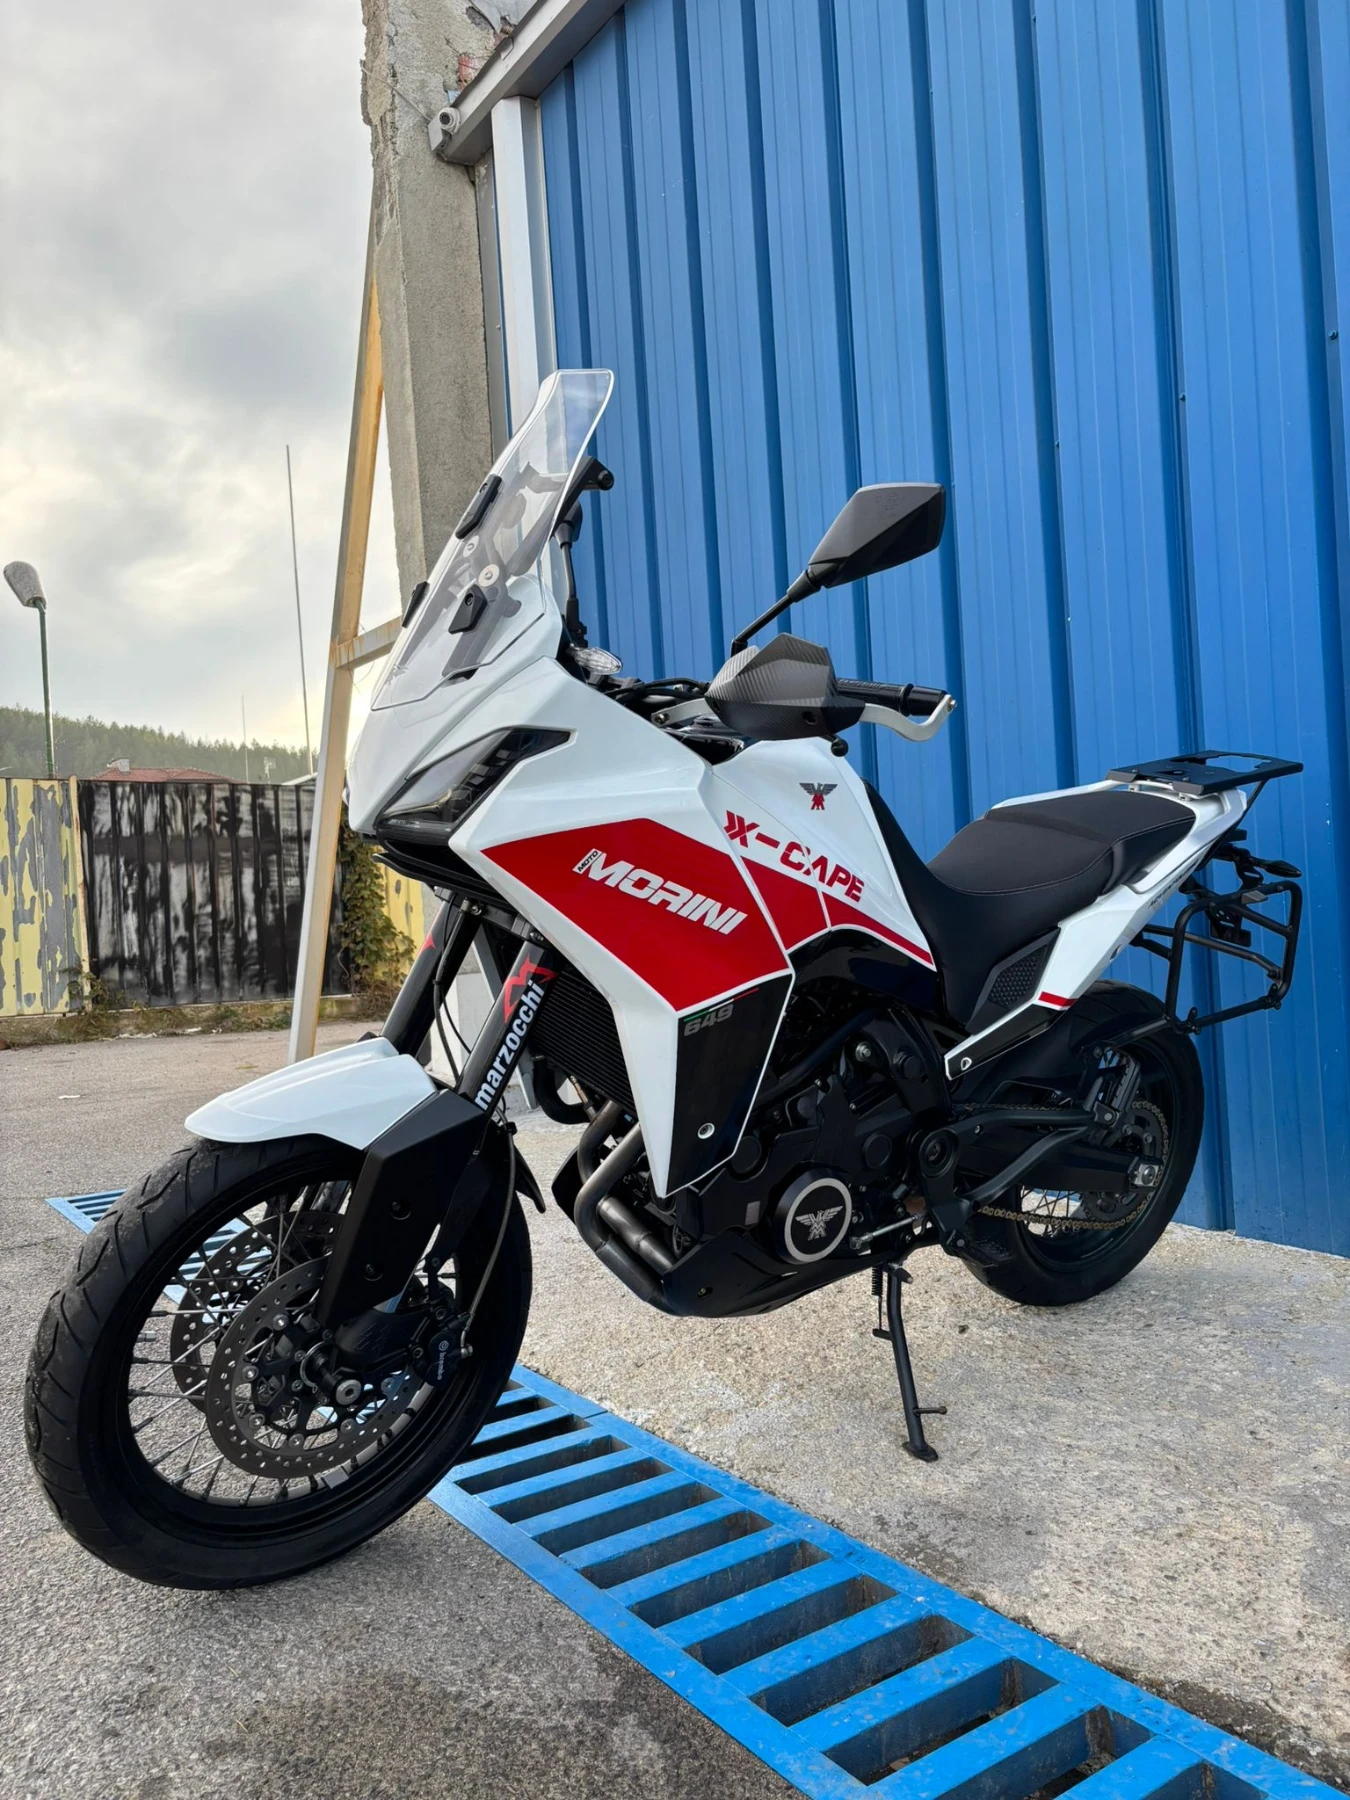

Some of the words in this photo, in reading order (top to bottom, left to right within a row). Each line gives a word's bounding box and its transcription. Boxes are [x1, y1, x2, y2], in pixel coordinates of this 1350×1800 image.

[577, 850, 599, 872] MOTO
[588, 852, 748, 935] MORINI
[724, 810, 865, 903] X-CAPE
[474, 979, 546, 1111] marzocchi
[684, 1003, 734, 1037] 649
[437, 1351, 447, 1380] brembo
